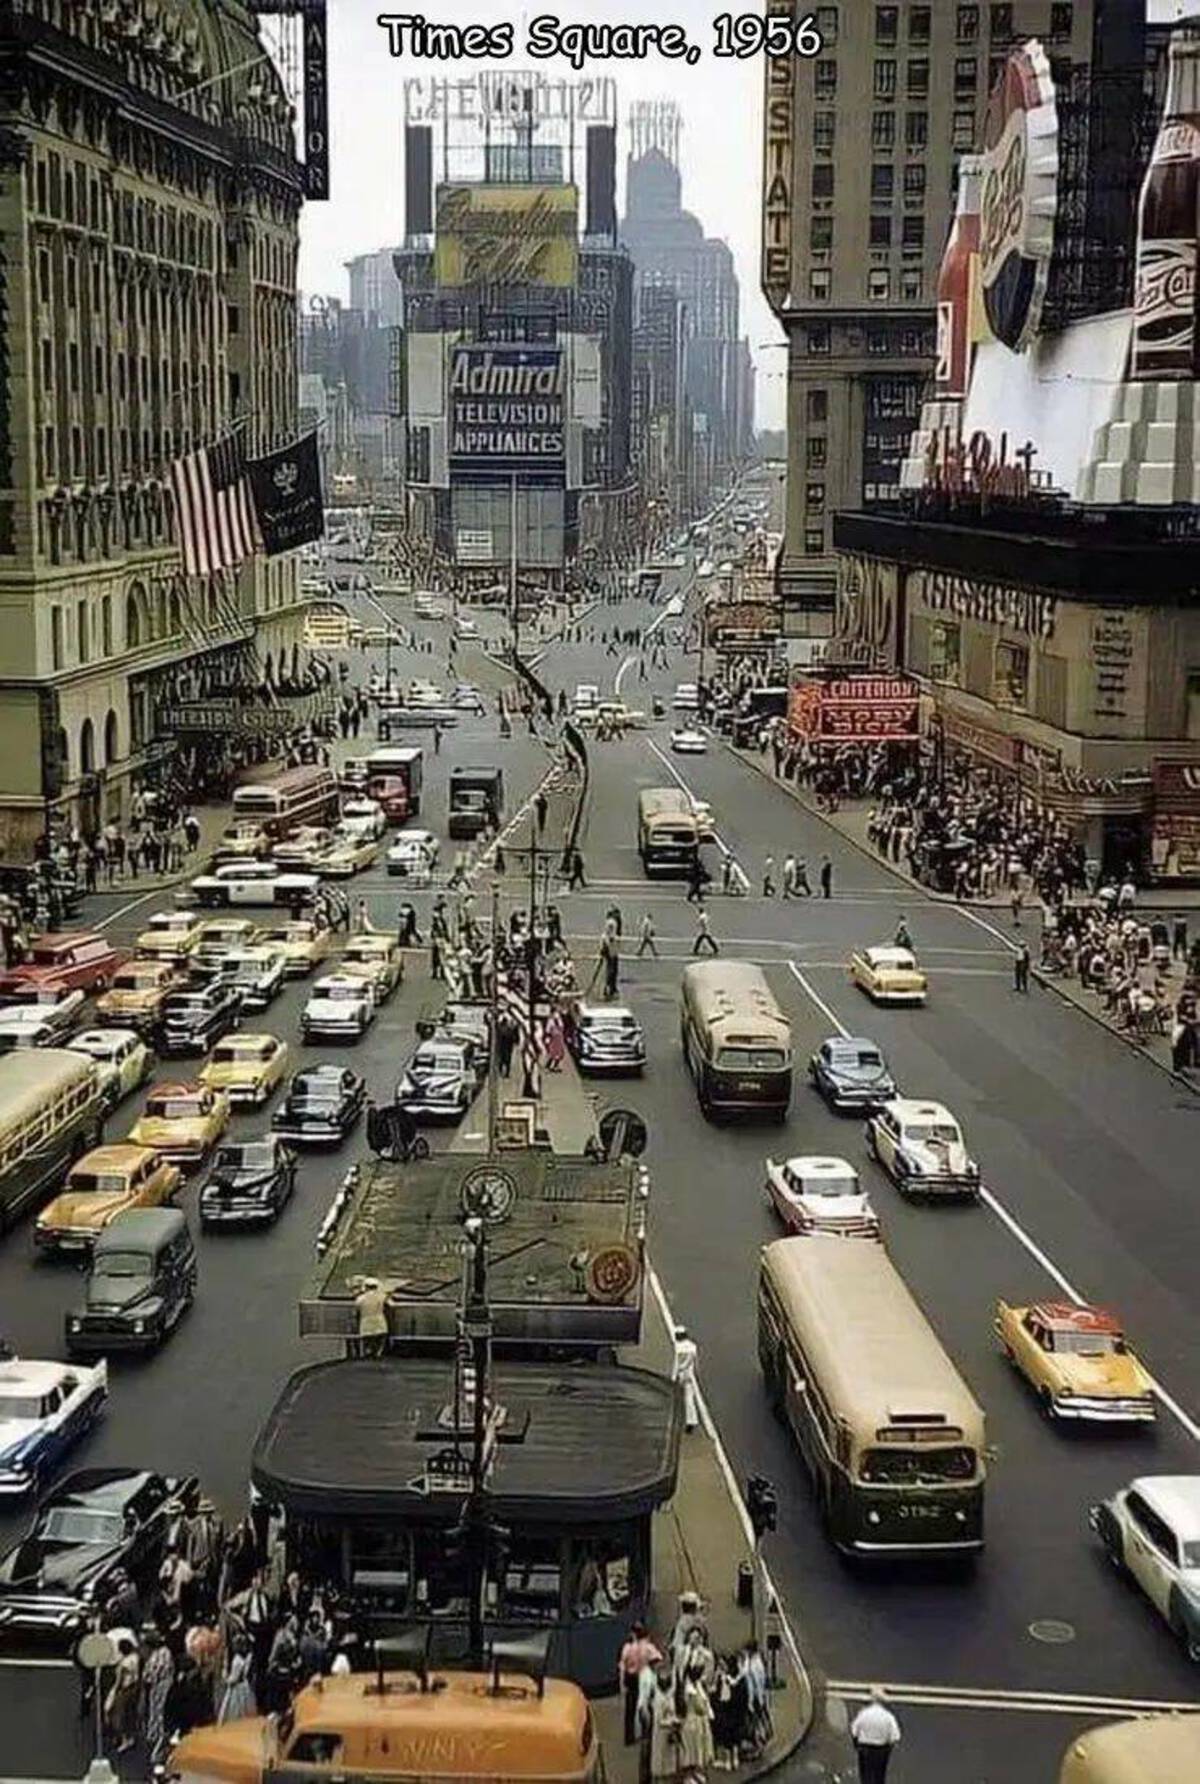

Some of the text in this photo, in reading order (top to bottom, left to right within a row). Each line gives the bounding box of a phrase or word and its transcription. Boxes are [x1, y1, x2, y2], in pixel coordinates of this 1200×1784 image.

[452, 351, 566, 396] Admiral
[455, 402, 562, 424] TELEVISION
[453, 431, 563, 453] APPLIANCES
